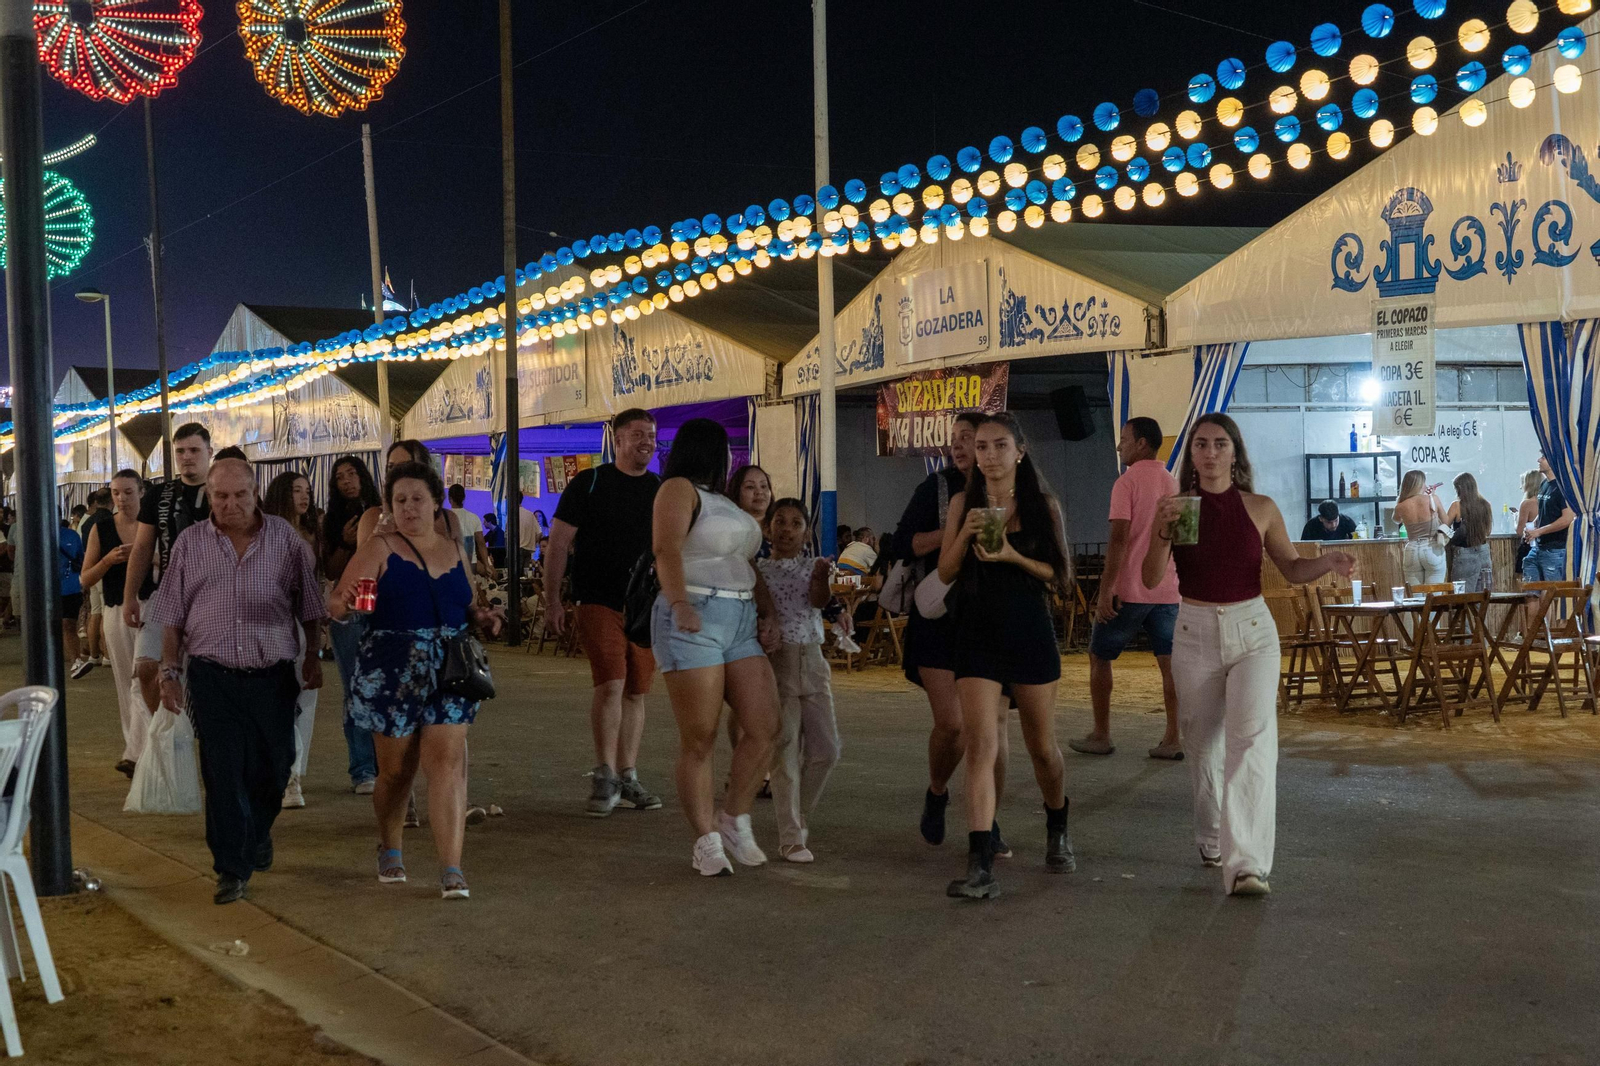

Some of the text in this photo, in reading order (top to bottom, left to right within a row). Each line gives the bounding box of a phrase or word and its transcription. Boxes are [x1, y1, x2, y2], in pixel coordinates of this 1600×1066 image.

[939, 286, 955, 305] LA
[915, 309, 984, 338] GOZADERA
[1377, 306, 1428, 326] EL COPAZO
[978, 335, 988, 346] 59
[1376, 325, 1428, 339] PRIMERAS MARCAS
[1390, 340, 1414, 351] A ELEGIR
[529, 362, 579, 389] SURTIDOR
[1380, 361, 1424, 381] COPA 3€
[575, 389, 582, 400] 55
[896, 375, 981, 413] GOZADERA
[1381, 390, 1412, 407] MACETA
[1394, 408, 1413, 426] 6€
[1411, 446, 1450, 463] COPA 3€
